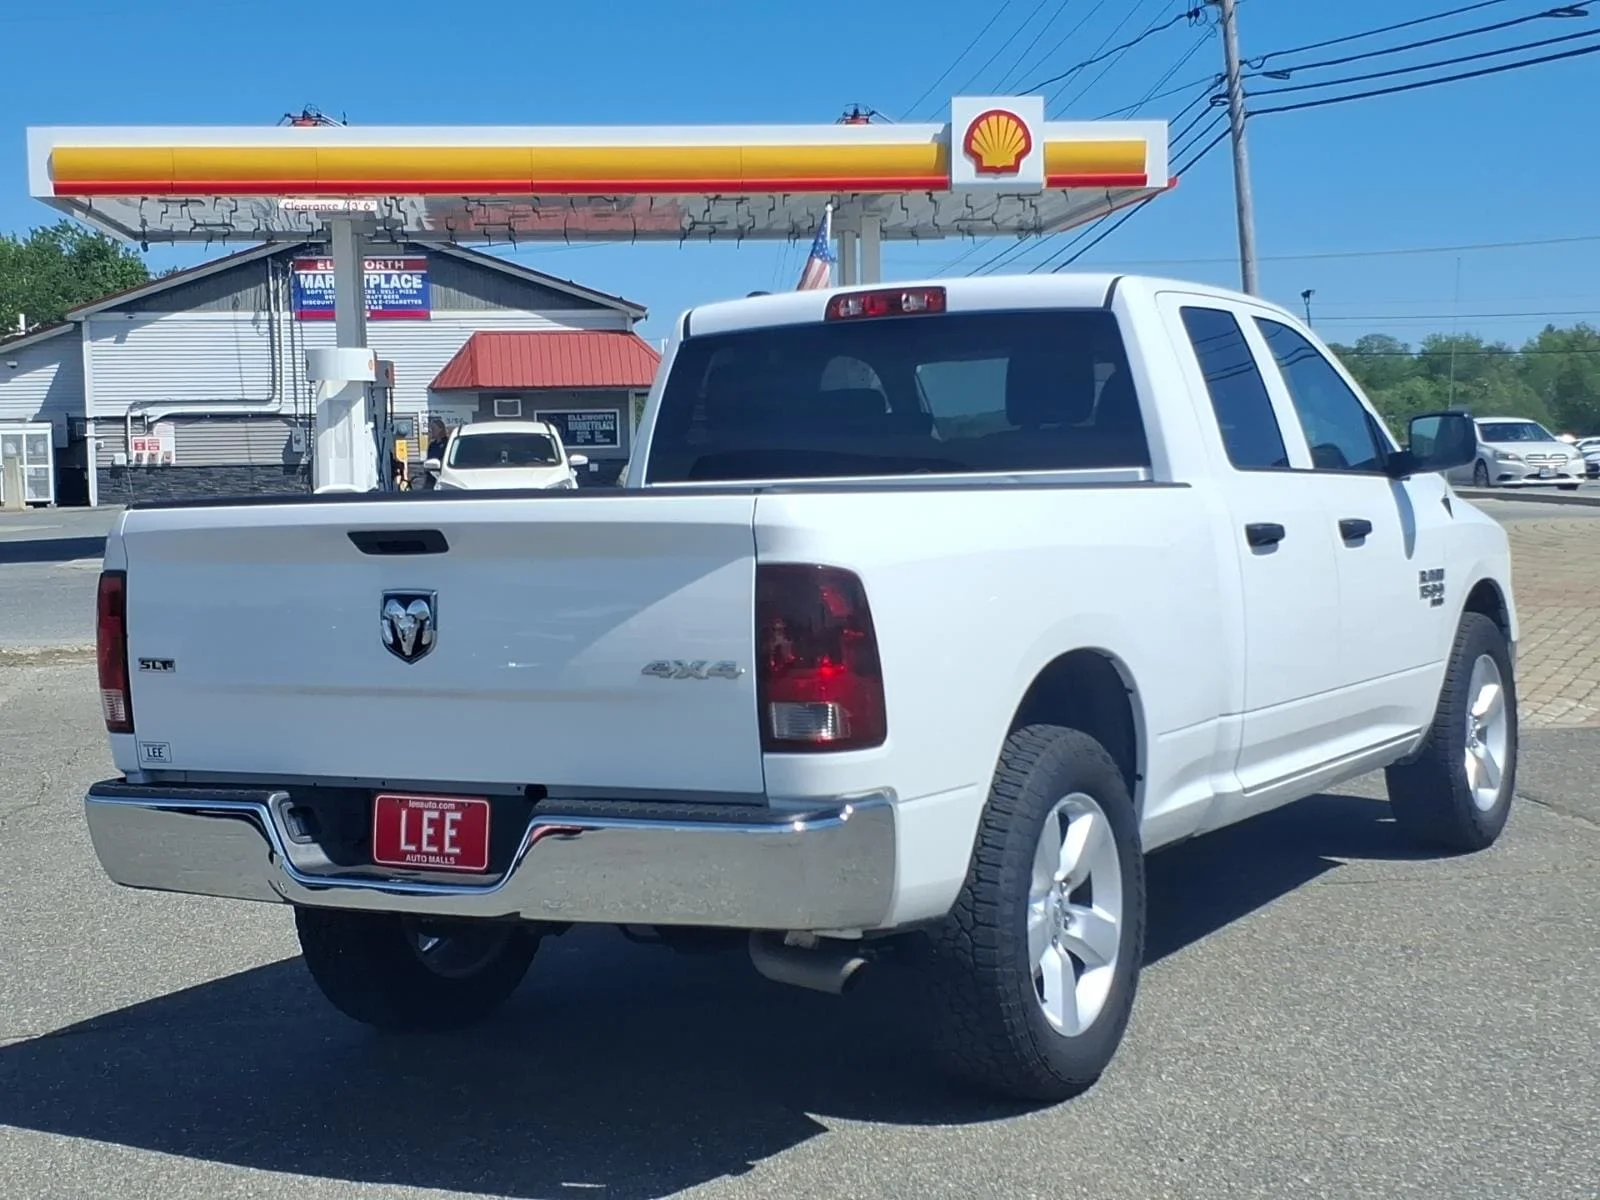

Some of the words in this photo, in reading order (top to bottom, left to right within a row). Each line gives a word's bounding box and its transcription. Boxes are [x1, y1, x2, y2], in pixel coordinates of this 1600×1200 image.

[284, 202, 339, 211] Clearance
[317, 260, 405, 270] ELORTH
[300, 274, 423, 289] MARTPLACE
[139, 659, 175, 671] SLT
[146, 747, 164, 758] LEE
[408, 799, 456, 810] leeauto.com
[400, 808, 462, 854] LEE
[405, 854, 427, 863] AUTO
[428, 855, 455, 865] MALLS
